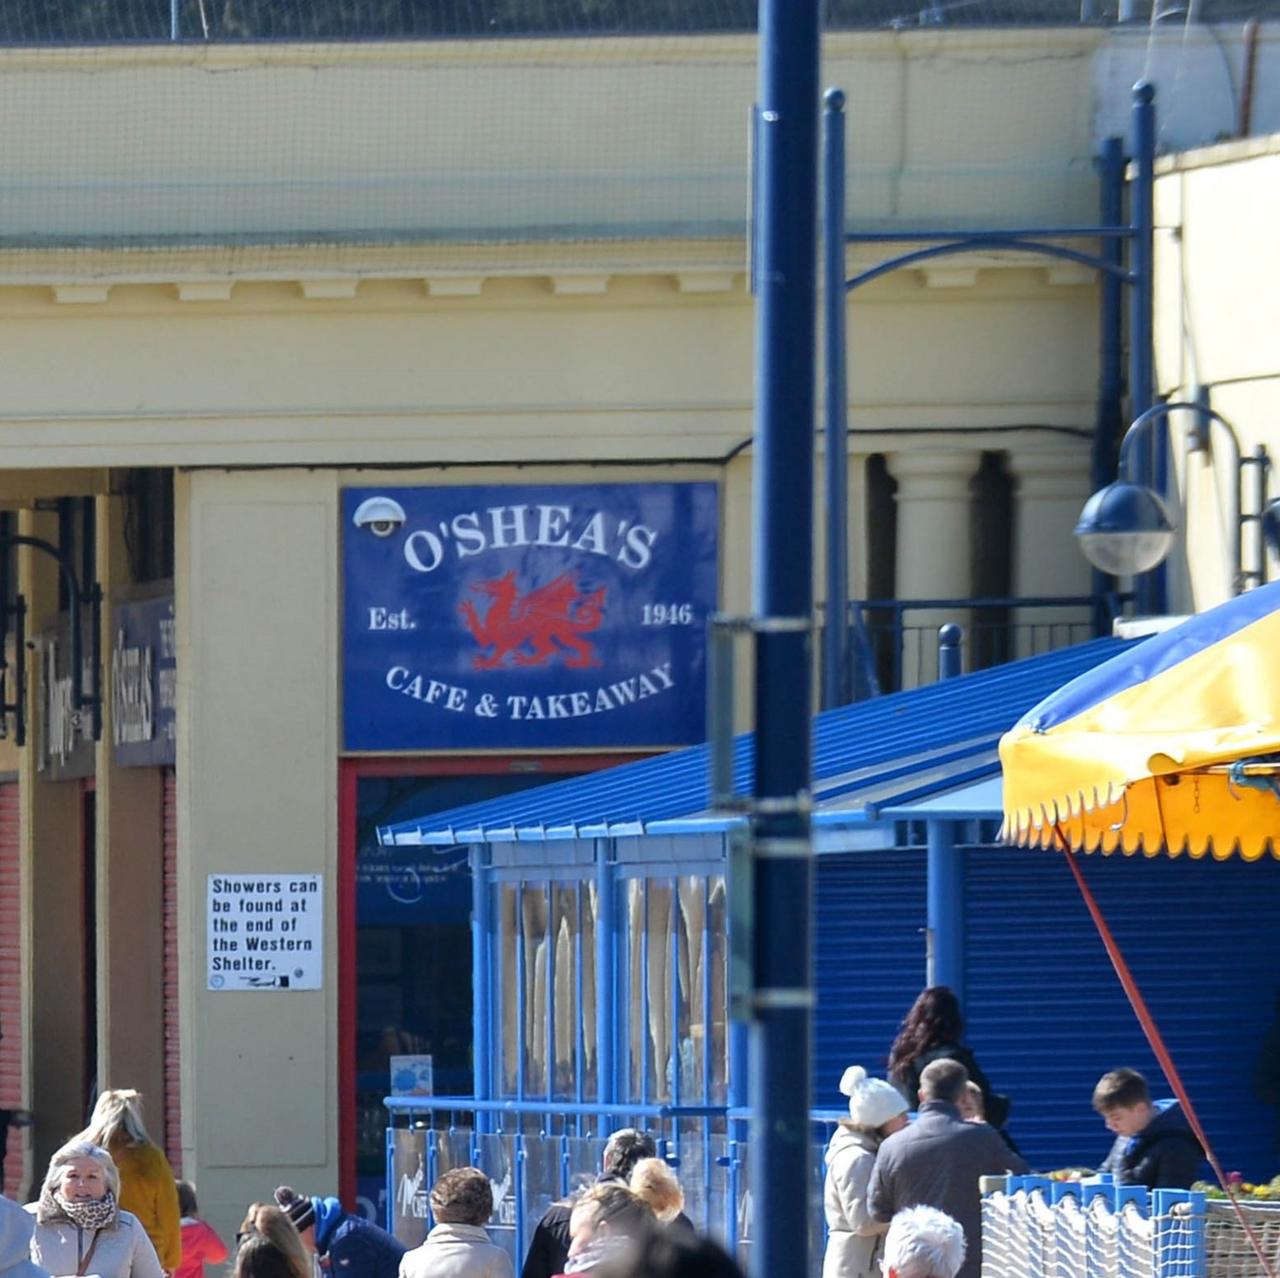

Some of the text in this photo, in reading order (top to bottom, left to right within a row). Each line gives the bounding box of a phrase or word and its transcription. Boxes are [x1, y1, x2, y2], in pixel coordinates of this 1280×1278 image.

[403, 504, 658, 572] O'SHEA'S
[368, 607, 416, 631] Est.
[641, 603, 693, 626] 1946
[385, 662, 675, 721] CAFE & TAKEAWAY
[212, 879, 318, 893] Showers can
[212, 898, 307, 912] be found at
[213, 917, 297, 932] the end of
[213, 937, 312, 952] the Western
[212, 956, 276, 971] Shelter.
